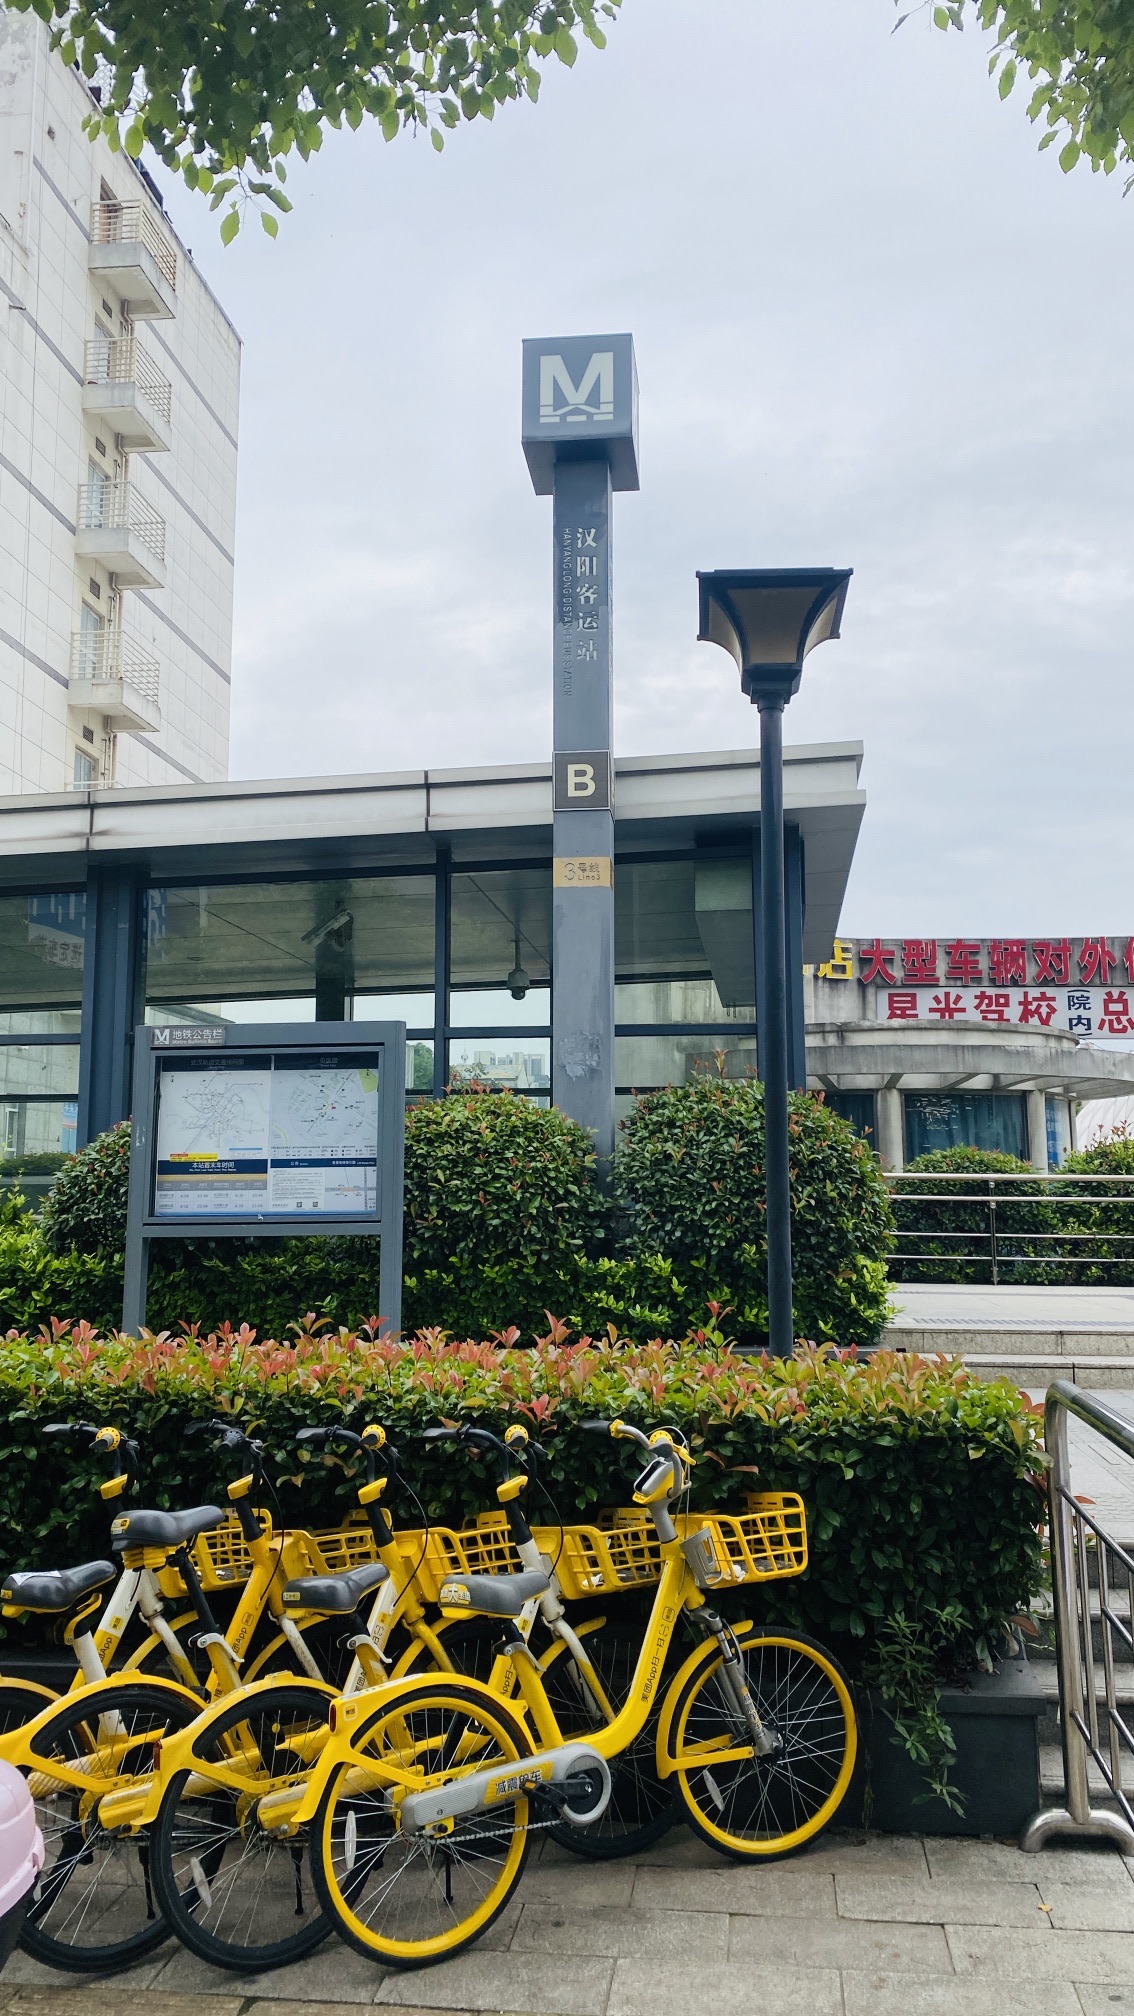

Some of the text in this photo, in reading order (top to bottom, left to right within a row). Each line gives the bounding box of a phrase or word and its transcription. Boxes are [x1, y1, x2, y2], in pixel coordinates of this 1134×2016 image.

[563, 528, 573, 569] HANYANG
[576, 527, 599, 662] 汉阳客运站
[563, 660, 573, 697] STATION
[567, 763, 596, 797] B
[860, 936, 1134, 985] 大型车辆对外
[172, 1028, 223, 1039] 地铁公告栏
[641, 1637, 665, 1704] 美团App扫一扫
